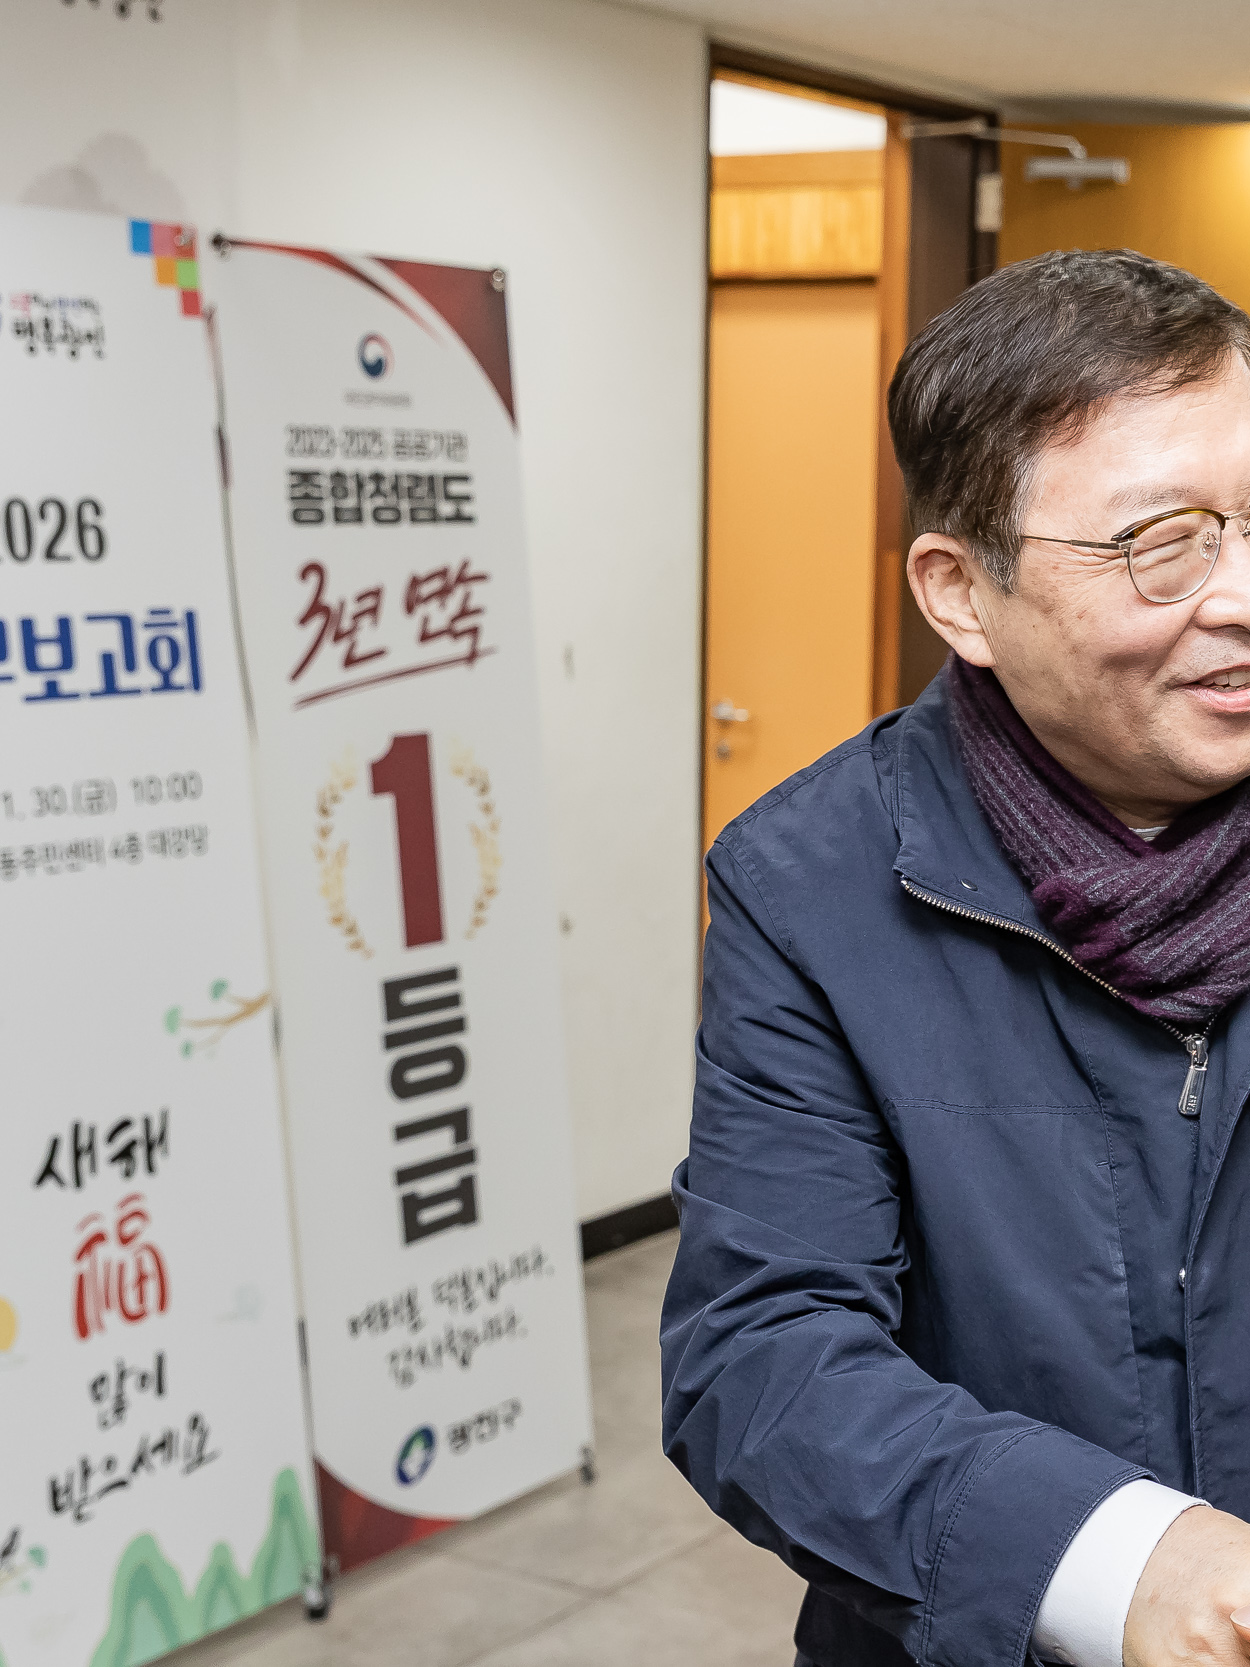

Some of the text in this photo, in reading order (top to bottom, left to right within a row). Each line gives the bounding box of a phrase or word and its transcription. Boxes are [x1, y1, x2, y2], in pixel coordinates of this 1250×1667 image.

[0, 498, 106, 562] 026
[289, 470, 475, 524] 종합청렴도
[290, 562, 386, 682] 3년
[131, 772, 203, 805] 10:00
[370, 732, 444, 948] 1
[383, 967, 478, 1244] 등급
[35, 1109, 168, 1188] 새해
[90, 1352, 168, 1430] 많이
[447, 1399, 521, 1454] 광진구
[49, 1411, 221, 1523] 받으세요
